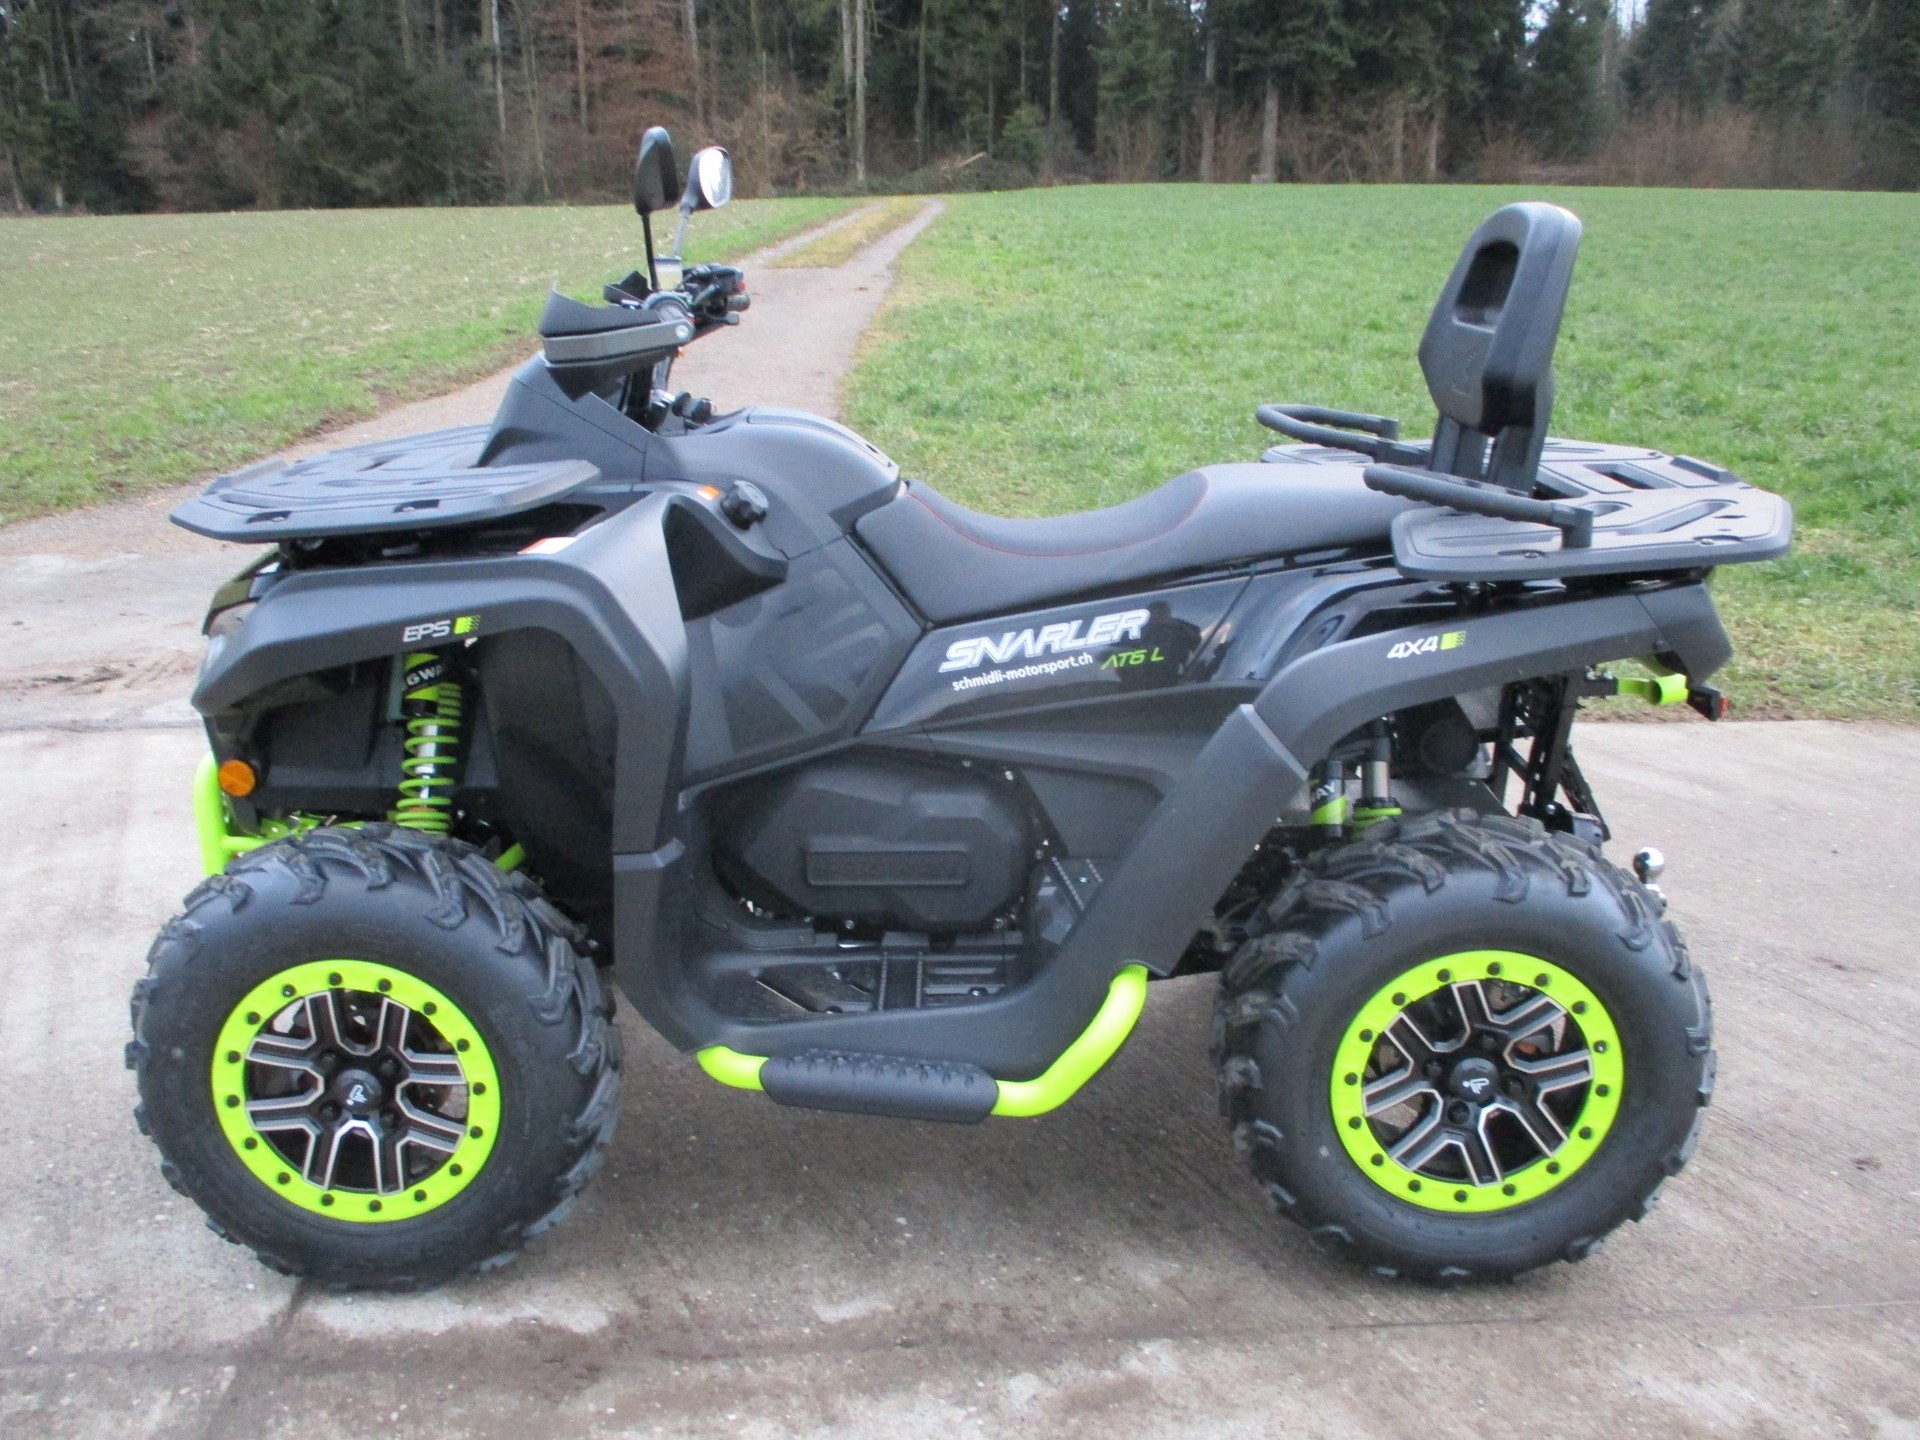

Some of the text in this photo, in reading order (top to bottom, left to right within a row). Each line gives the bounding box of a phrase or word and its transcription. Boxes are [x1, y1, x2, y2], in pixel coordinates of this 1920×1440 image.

[403, 620, 451, 642] EPS
[938, 608, 1150, 673] SNARLER
[952, 652, 1093, 691] schmidli-motorsport.ch
